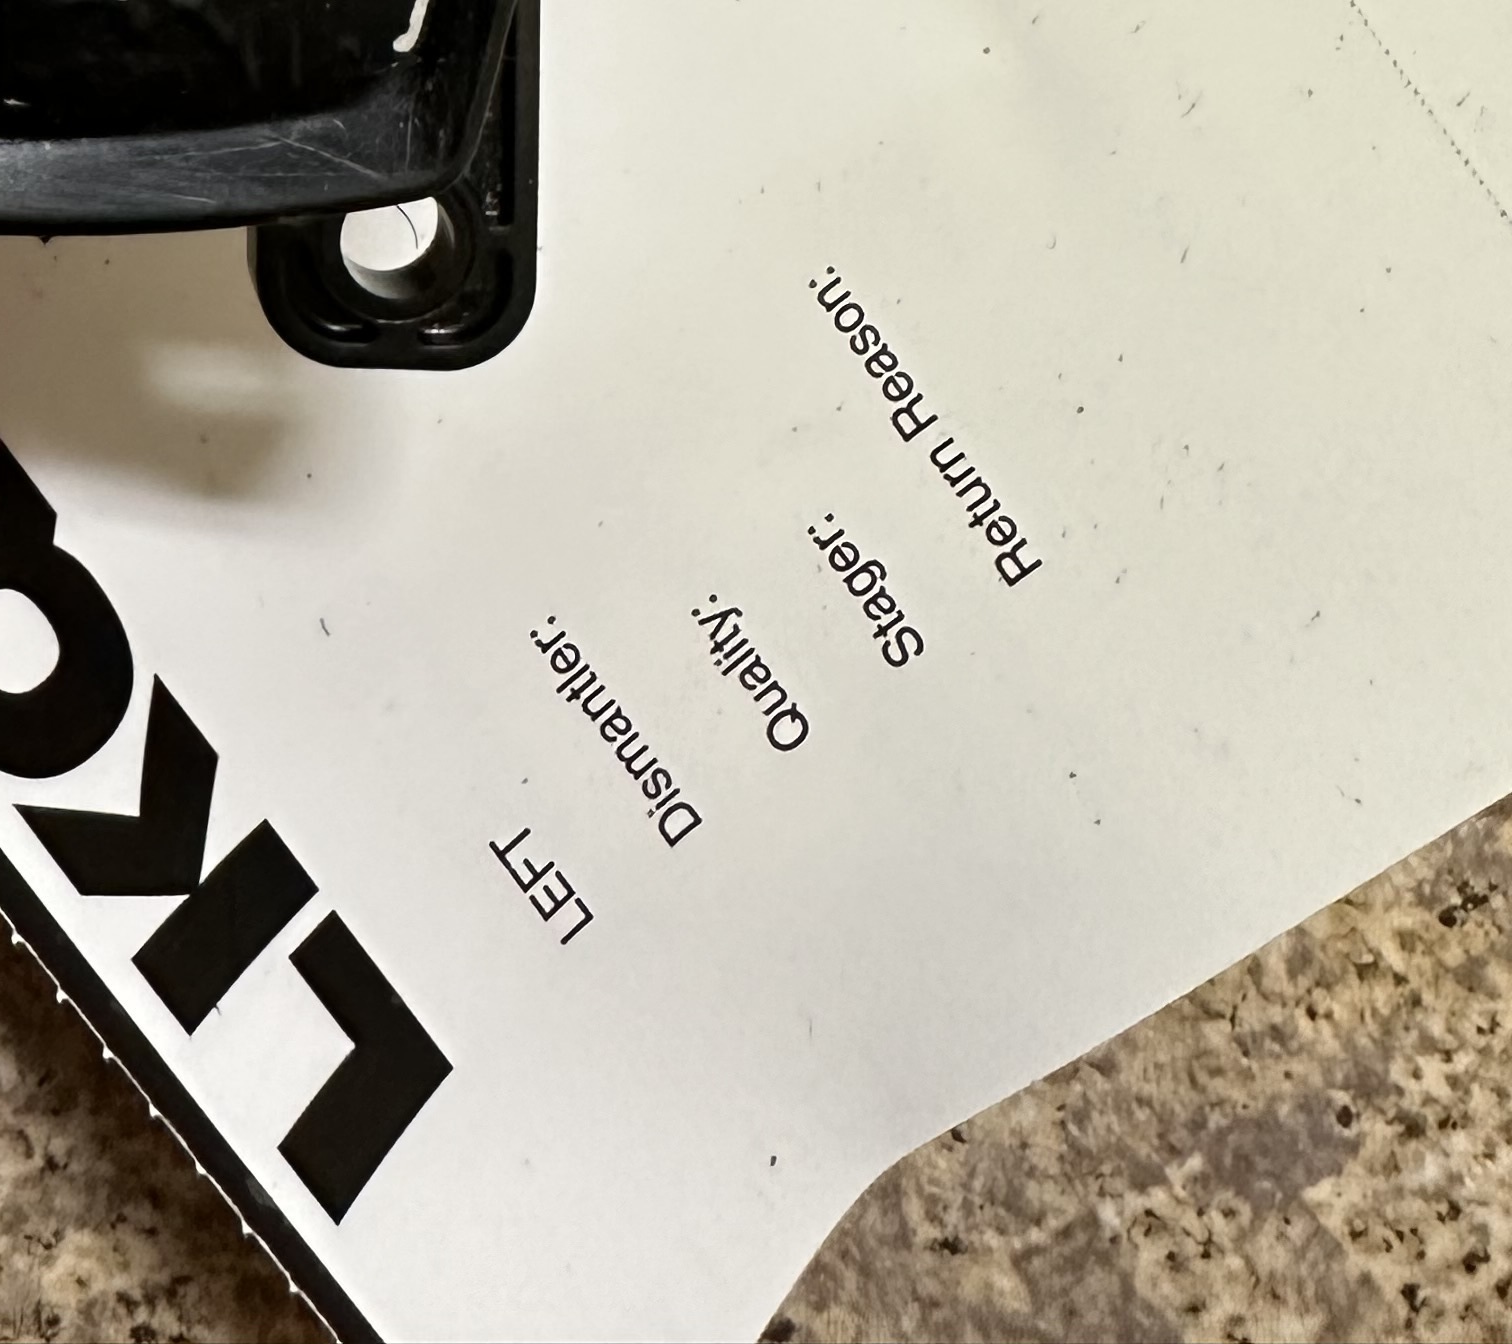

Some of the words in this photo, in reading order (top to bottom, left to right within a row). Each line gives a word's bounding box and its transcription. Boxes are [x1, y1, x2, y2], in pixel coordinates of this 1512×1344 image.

[806, 264, 940, 444] Reason:
[805, 511, 926, 669] Stager:
[927, 435, 1044, 588] Return
[528, 614, 704, 849] Dismantler:
[689, 593, 810, 754] Quality:
[488, 826, 595, 947] LEFT
